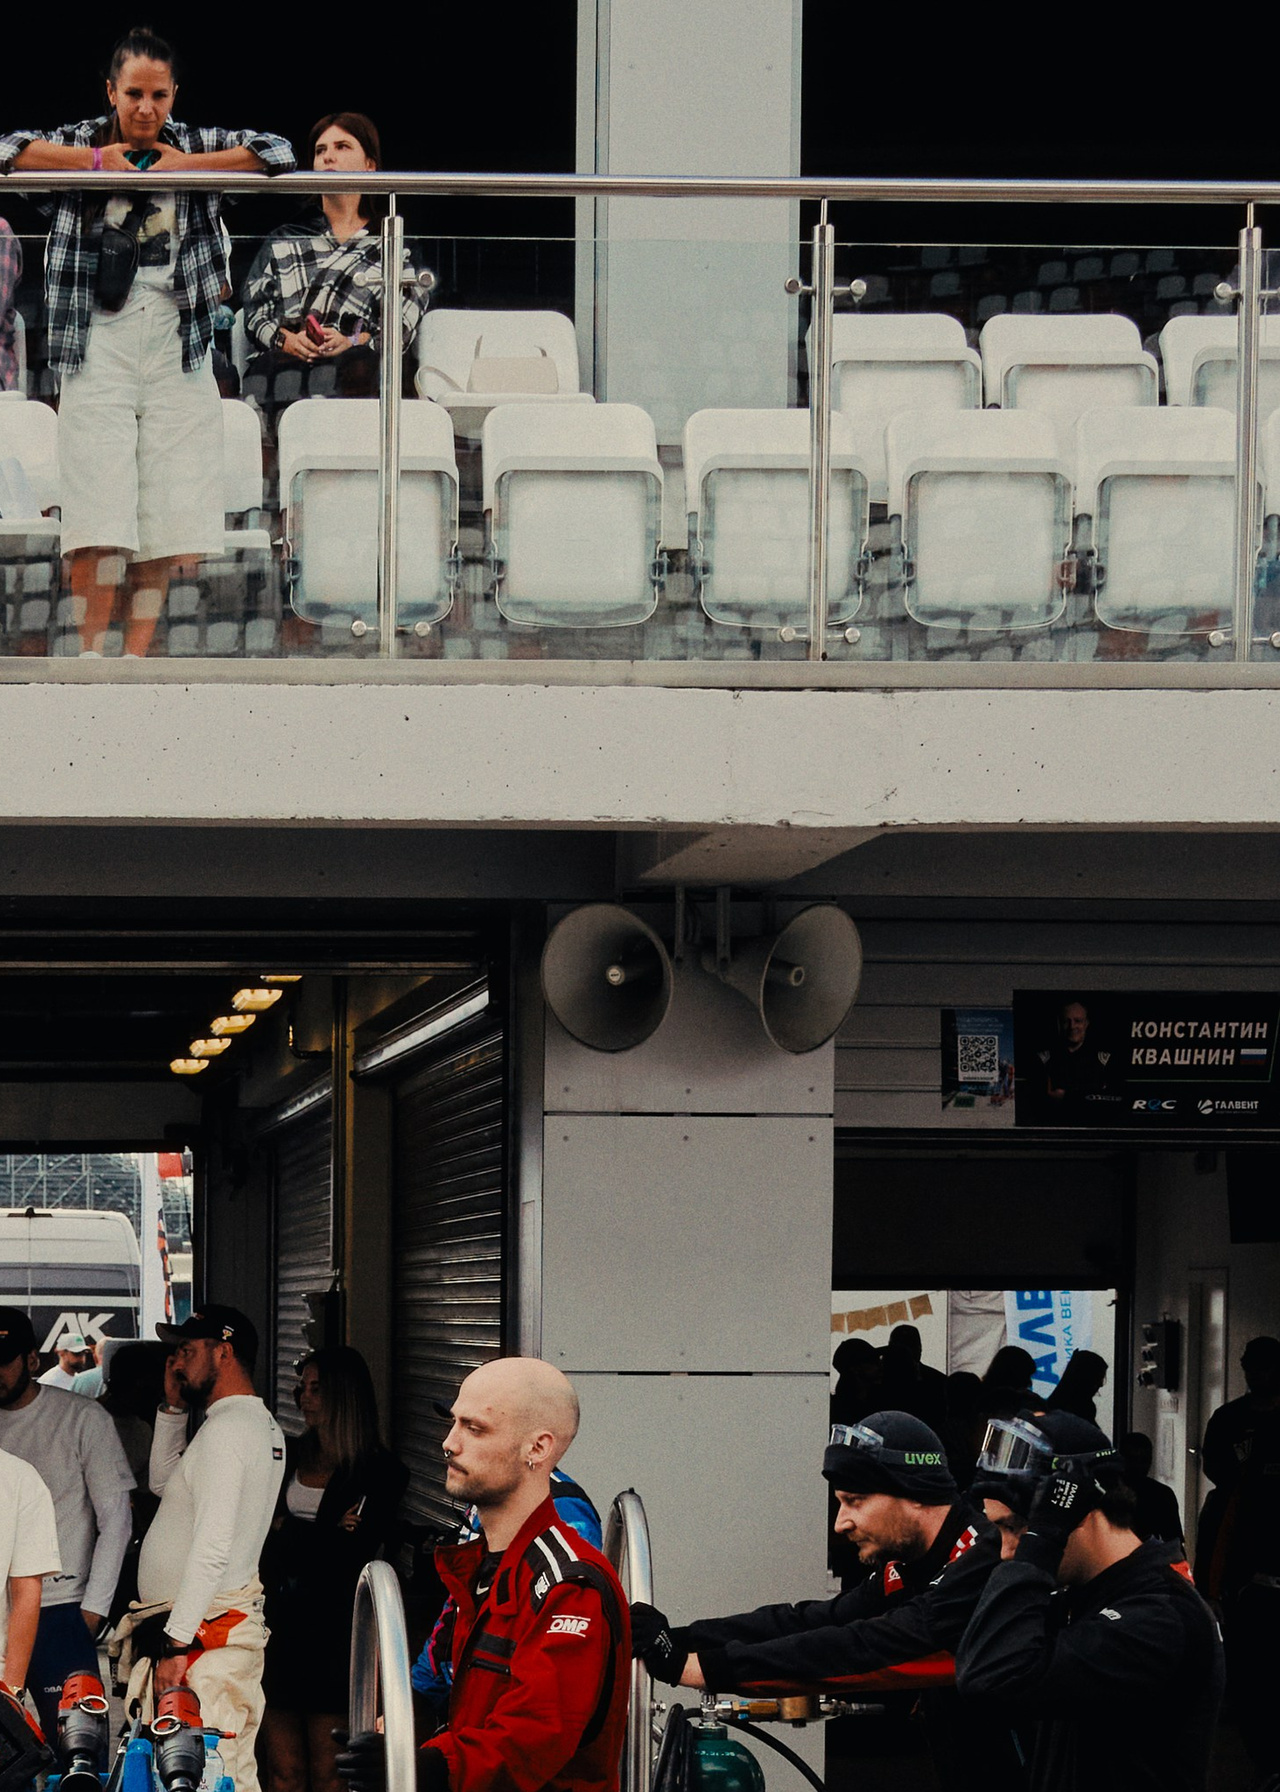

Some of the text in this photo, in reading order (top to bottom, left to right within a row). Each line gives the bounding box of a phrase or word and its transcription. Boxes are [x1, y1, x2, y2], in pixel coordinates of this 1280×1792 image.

[1130, 1021, 1269, 1039] КОНСТАНТИН
[1130, 1048, 1235, 1065] КВАШНИН
[39, 1312, 116, 1354] AK
[904, 1452, 941, 1466] uvex
[548, 1617, 589, 1635] OMP
